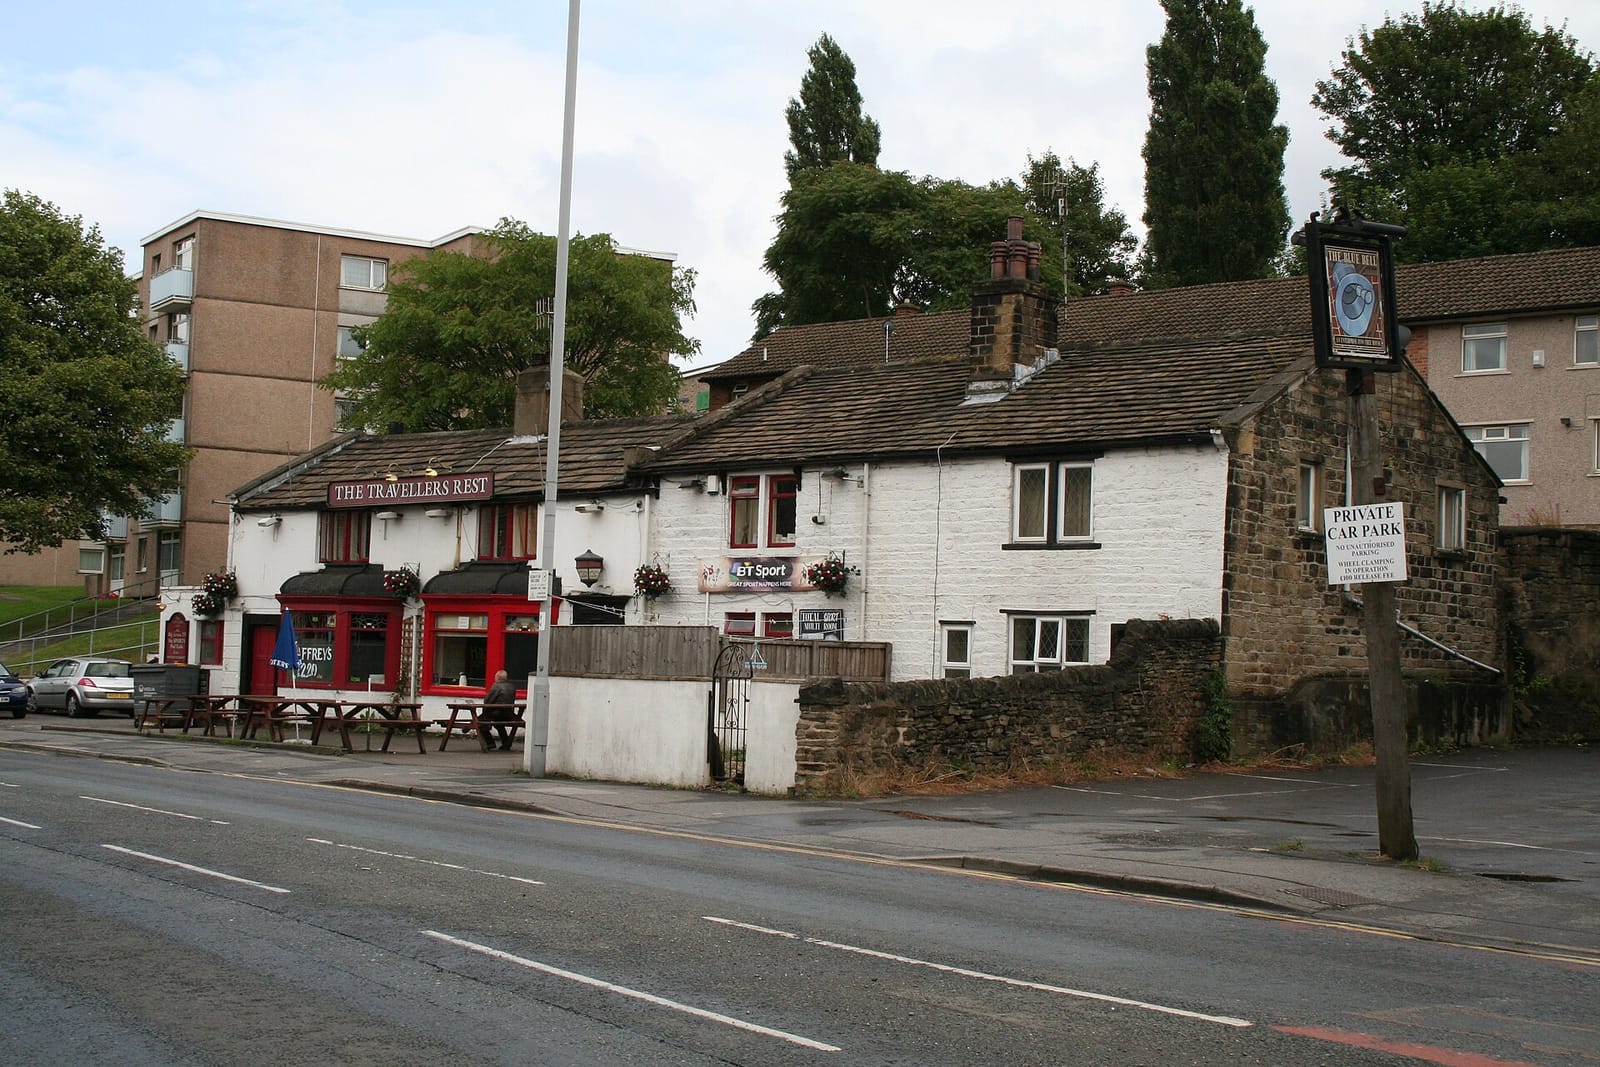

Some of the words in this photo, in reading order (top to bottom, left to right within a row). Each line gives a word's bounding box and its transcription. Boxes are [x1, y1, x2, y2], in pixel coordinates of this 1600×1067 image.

[1328, 250, 1341, 262] THE
[1343, 252, 1360, 264] BLUE
[335, 485, 363, 500] THE
[367, 480, 449, 499] TRAVELLERS
[453, 477, 488, 495] REST
[1333, 505, 1395, 523] PRIVATE
[1328, 525, 1358, 540] CAR
[1362, 522, 1402, 538] PARK
[1346, 541, 1395, 550] UNAUTHORISED
[1352, 549, 1379, 557] PARKING
[1338, 560, 1361, 568] WHEEL
[1361, 558, 1395, 566] CLAMPING
[1353, 565, 1389, 573] OPERATION
[736, 565, 755, 577] BT
[755, 564, 786, 578] Sport
